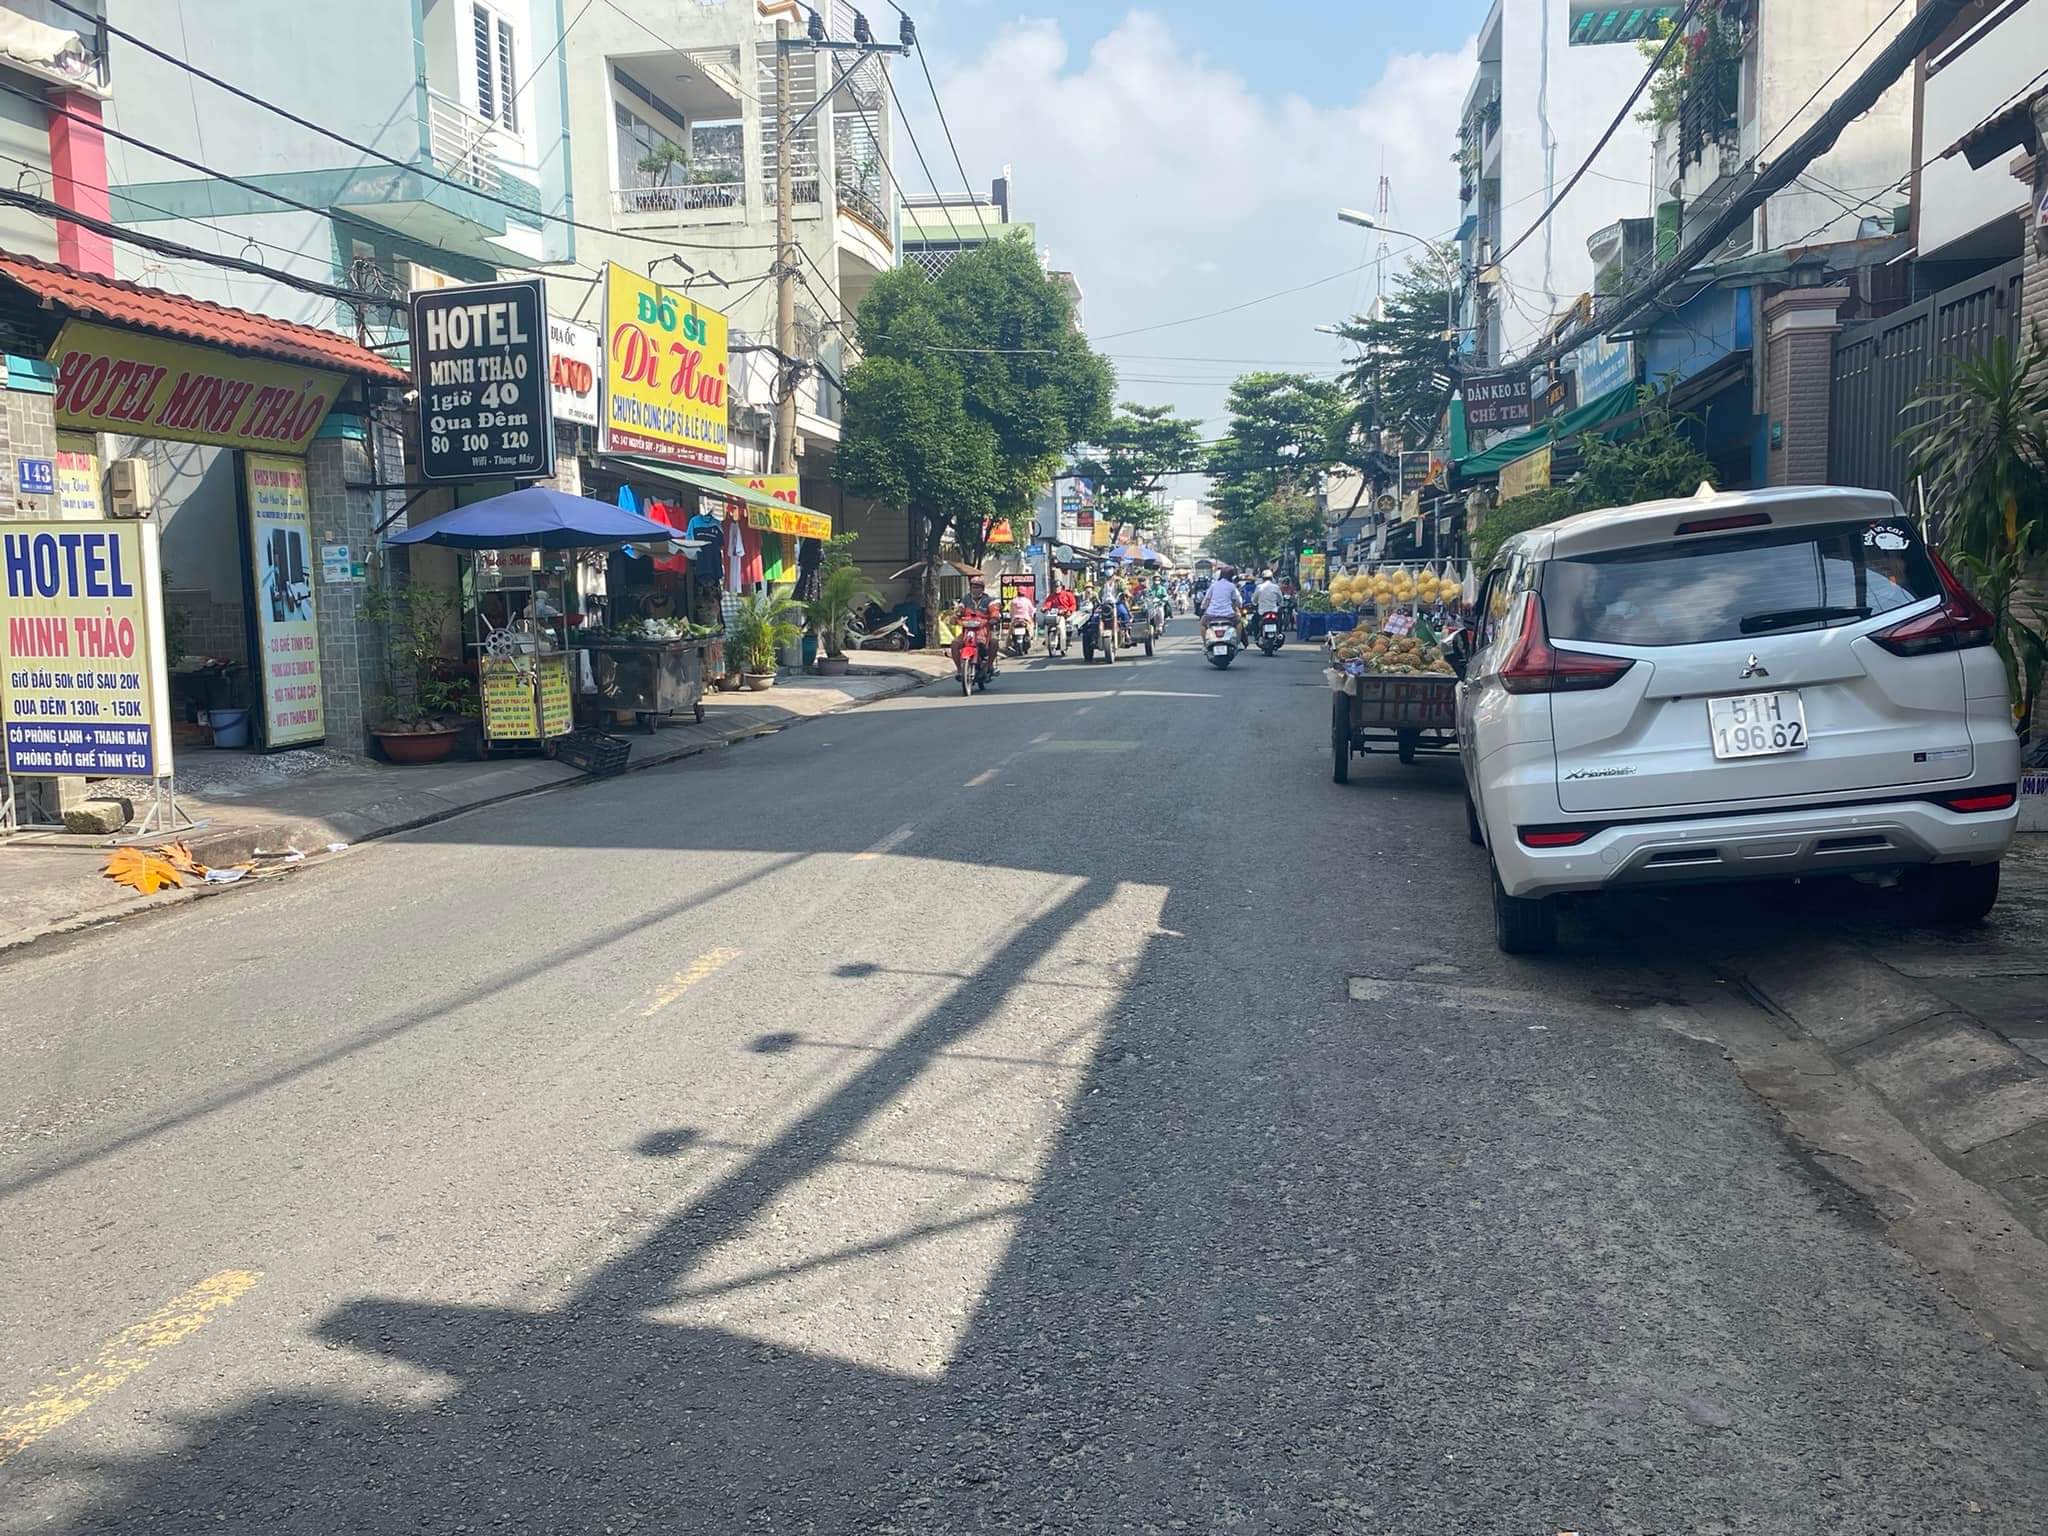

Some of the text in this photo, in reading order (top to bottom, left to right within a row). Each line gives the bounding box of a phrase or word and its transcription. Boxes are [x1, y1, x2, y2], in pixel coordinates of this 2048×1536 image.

[638, 292, 679, 332] ĐỒ
[426, 301, 528, 351] HOTEL
[564, 326, 575, 346] ỐC
[430, 345, 527, 386] MINH THẢO
[613, 323, 726, 408] Dì Hai
[56, 352, 325, 440] HOTEL MINH THẢO
[481, 382, 519, 408] 40
[1491, 384, 1511, 399] KEO
[1513, 382, 1527, 396] XE
[430, 411, 528, 434] Qua Đêm
[612, 393, 641, 425] CHUYÊN
[643, 403, 661, 431] CUNG
[1470, 401, 1528, 423] CHẾ TEM
[431, 431, 528, 453] 80 100 120
[494, 455, 517, 465] Thang
[519, 453, 535, 465] Máy
[22, 463, 51, 483] 143
[4, 532, 133, 598] HOTEL
[9, 606, 135, 659] MINH THẢO
[32, 668, 52, 689] ĐẦU
[55, 673, 74, 689] 50k
[77, 670, 94, 689] GIỜ
[97, 674, 117, 689] SAU
[120, 674, 140, 689] 20K
[14, 699, 37, 716] QUA
[40, 696, 67, 715] ĐÊM
[70, 701, 100, 716] 130k
[111, 701, 142, 716] 150K
[1732, 696, 1781, 724] 51H
[10, 726, 148, 747] CÓ PHÒNG LẠNH + THANG MÁY
[1720, 722, 1804, 753] 196.62
[16, 748, 146, 769] PHÒNG ĐÔI GHẾ TÌNH YÊU
